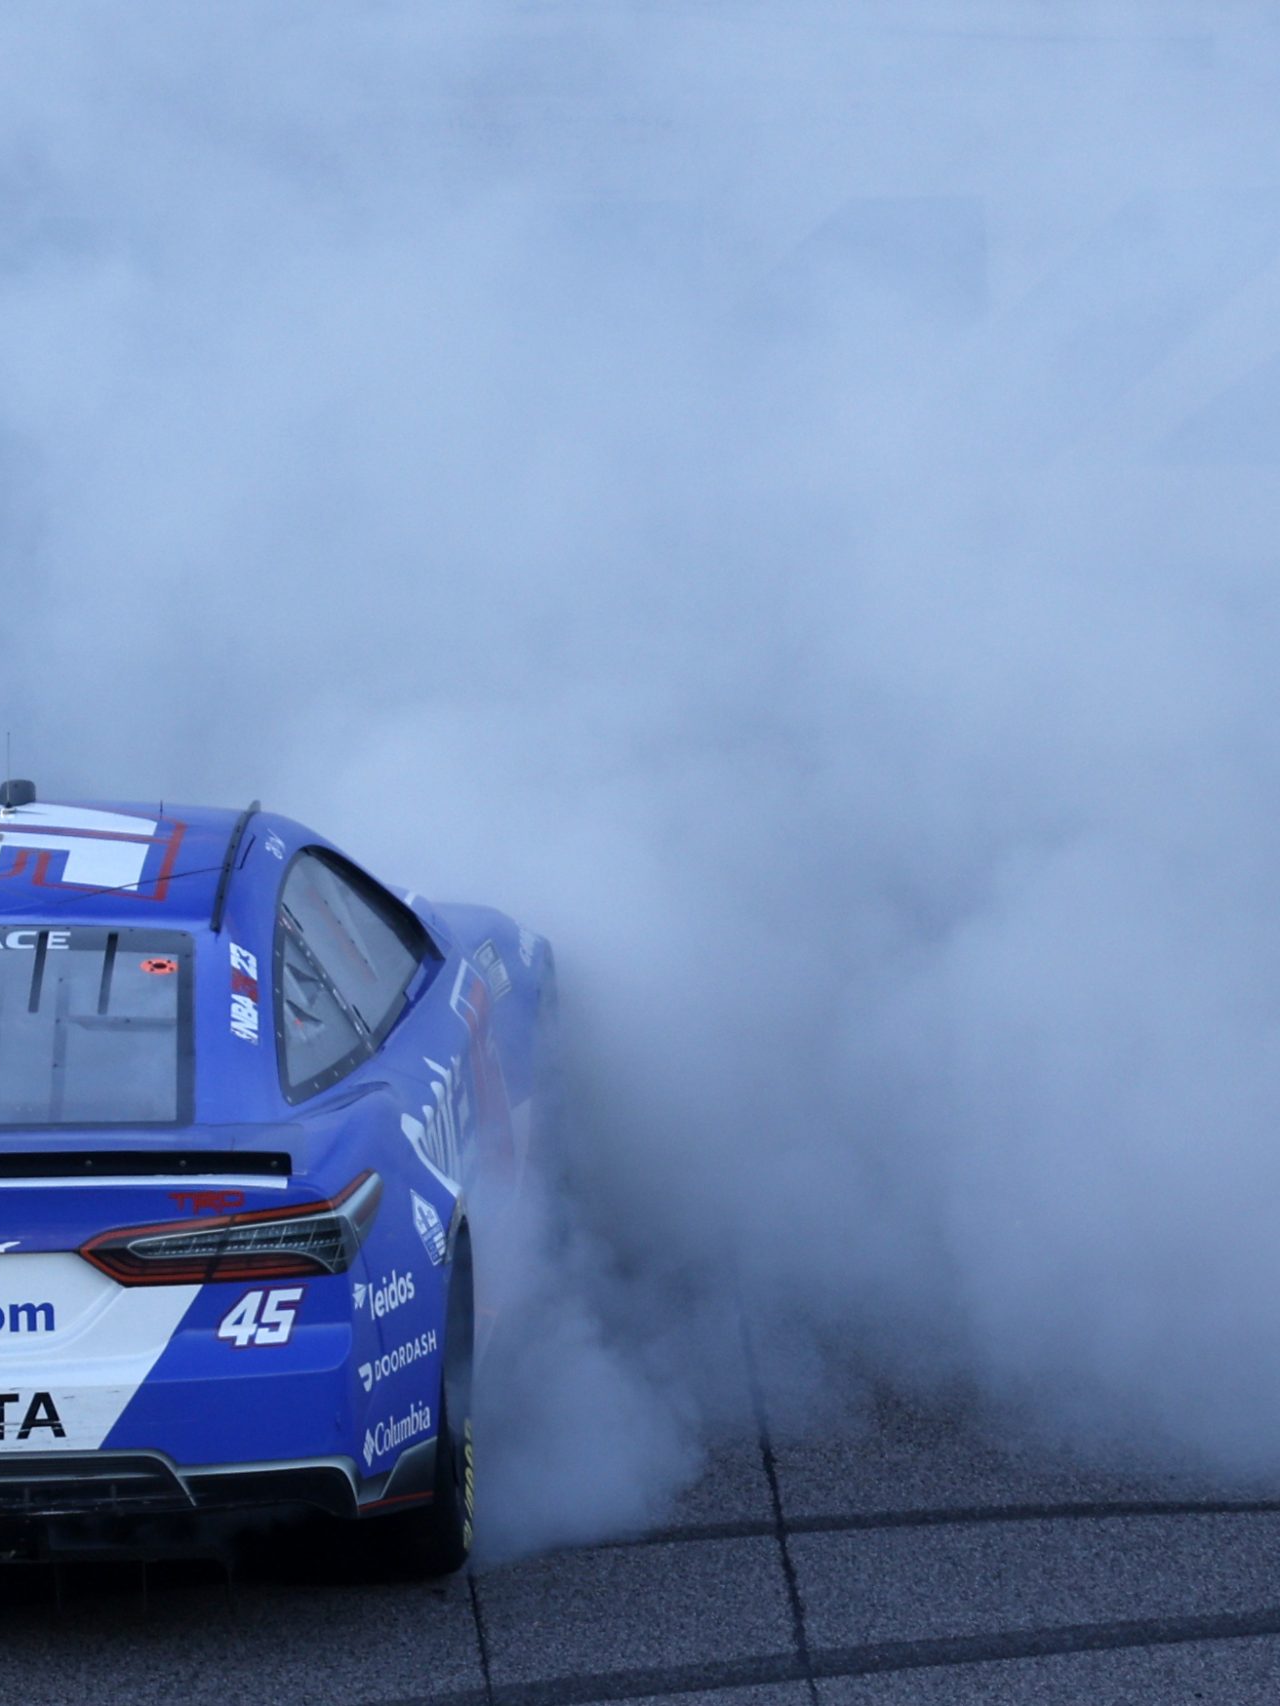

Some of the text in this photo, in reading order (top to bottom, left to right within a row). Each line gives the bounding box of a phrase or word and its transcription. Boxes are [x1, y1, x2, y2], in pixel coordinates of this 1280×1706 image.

[168, 1190, 245, 1215] TRD
[217, 1287, 304, 1347] 45
[368, 1270, 416, 1320] leidos
[374, 1329, 438, 1382] DOORDASH
[373, 1401, 432, 1456] Columbia
